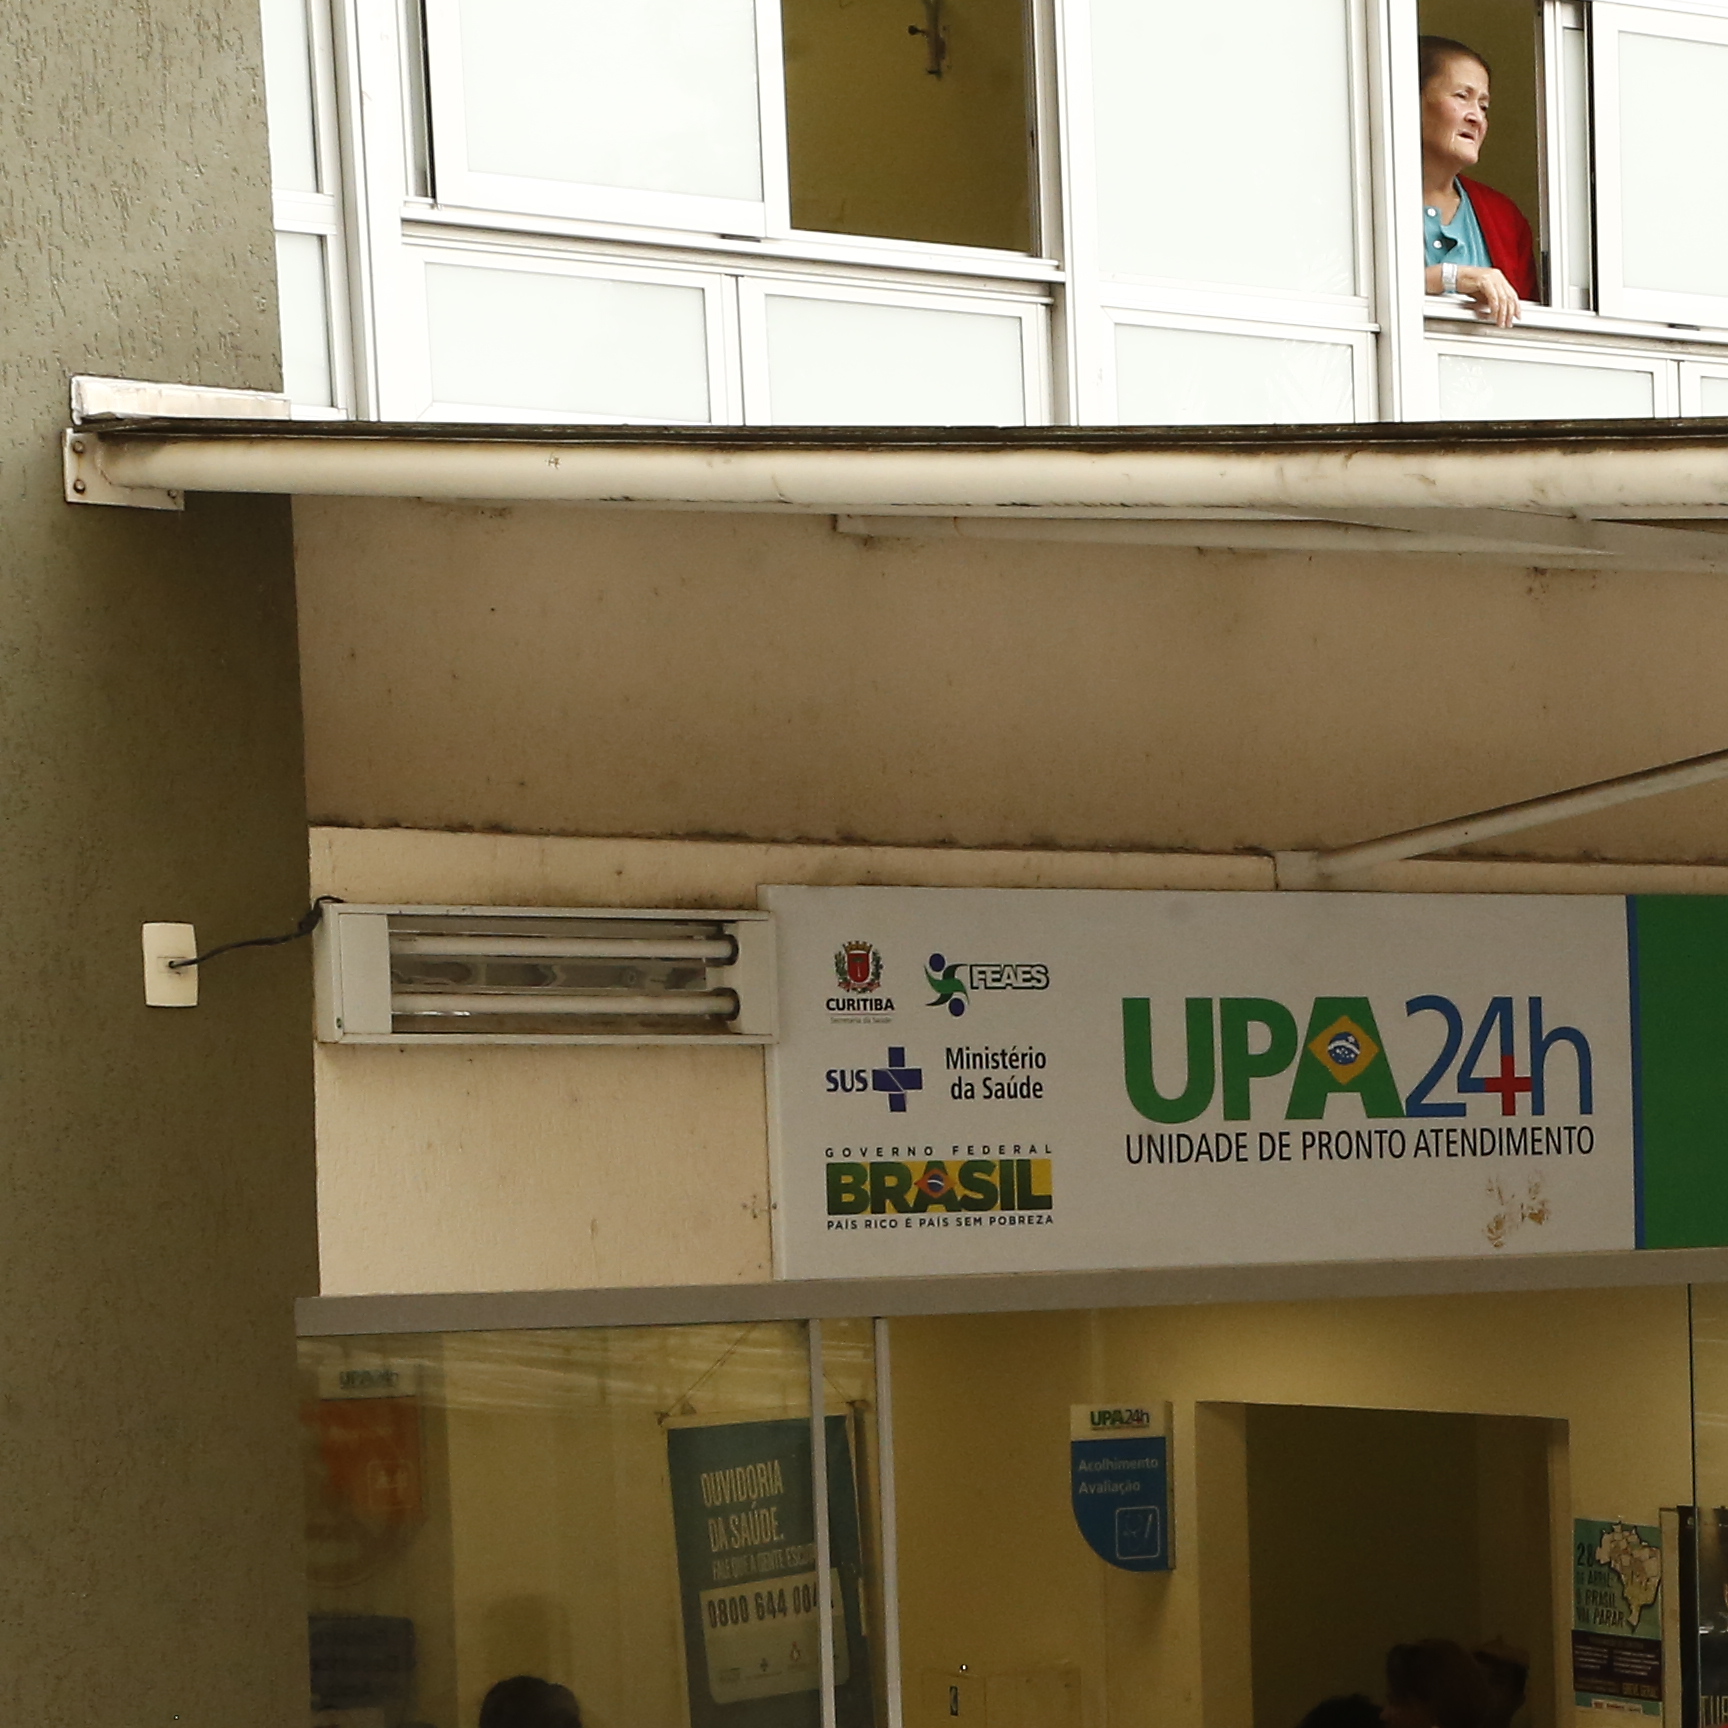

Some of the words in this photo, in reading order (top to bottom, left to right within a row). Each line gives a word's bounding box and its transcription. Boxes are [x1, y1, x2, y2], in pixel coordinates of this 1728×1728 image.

[969, 964, 1049, 989] FEAES
[826, 998, 894, 1011] CURITIBA
[945, 1046, 1047, 1070] Ministério
[826, 1069, 868, 1092] SUS
[951, 1077, 969, 1099] da
[983, 1075, 1043, 1099] Saúde
[825, 1146, 934, 1158] GOVERNO
[952, 1144, 1052, 1156] FEDERAL
[1126, 1129, 1252, 1165] UNIDADE
[1259, 1131, 1293, 1162] DE
[1300, 1128, 1406, 1161] PRONTO
[1412, 1125, 1594, 1159] ATENDIMENTO
[826, 1158, 1053, 1215] BRASIL
[827, 1217, 858, 1230] PAÍS
[865, 1218, 898, 1230] RICO
[919, 1215, 949, 1228] PAÍS
[956, 1215, 982, 1227] SEM
[989, 1213, 1053, 1226] POBREZA
[1079, 1457, 1159, 1472] Acolhimento
[700, 1459, 784, 1508] OUVIDORIA
[1079, 1479, 1141, 1495] Avaliação
[708, 1517, 728, 1552] DA
[707, 1595, 749, 1628] 0800
[754, 1588, 787, 1620] 644
